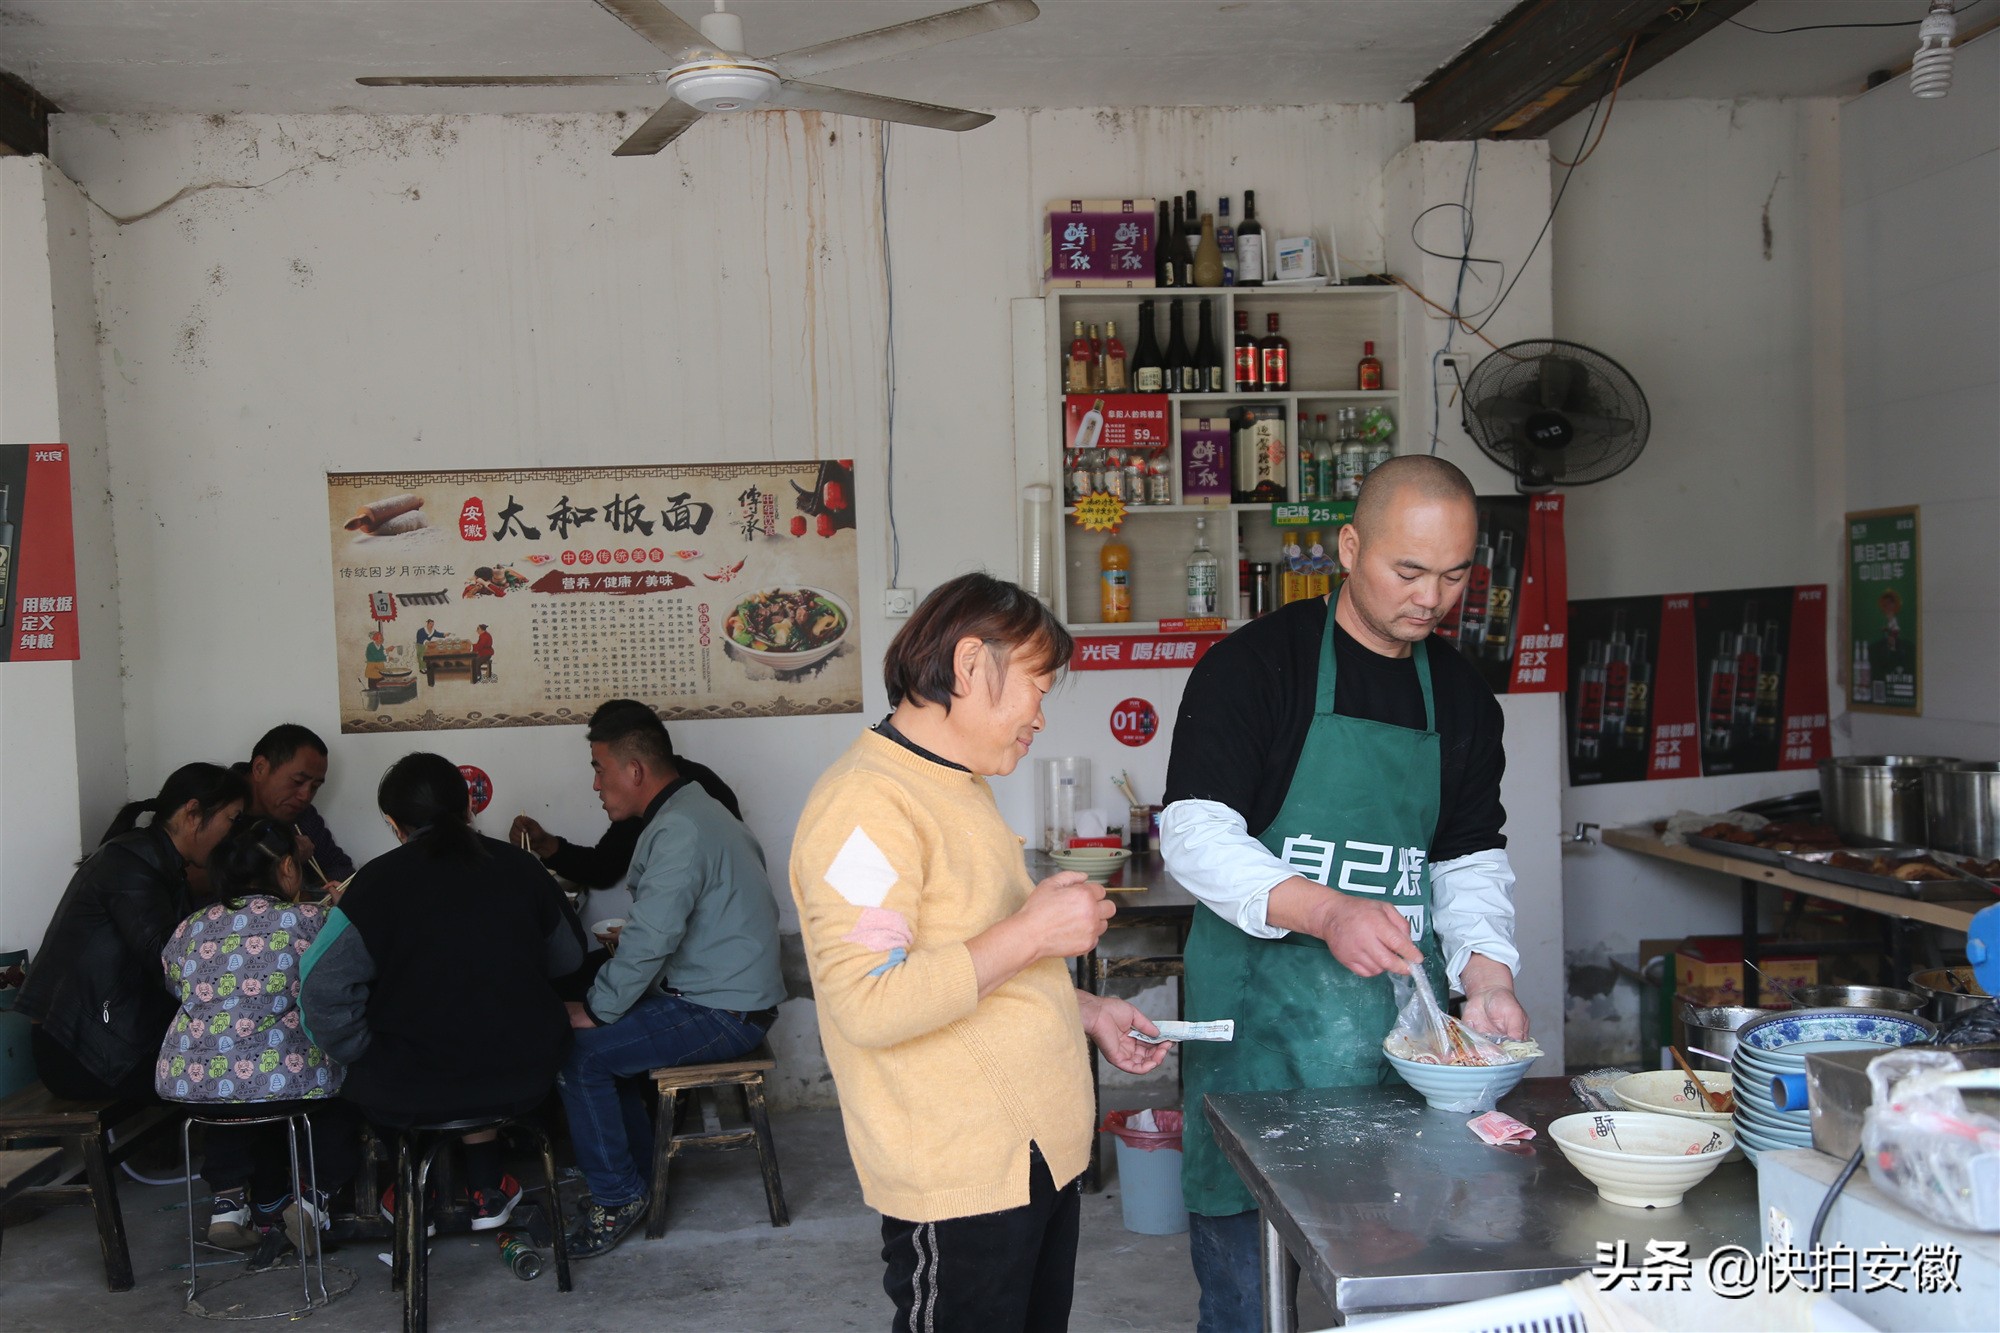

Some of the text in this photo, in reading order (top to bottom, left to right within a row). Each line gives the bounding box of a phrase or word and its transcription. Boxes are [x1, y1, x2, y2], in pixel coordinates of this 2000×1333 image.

[1134, 429, 1151, 440] 59
[35, 451, 63, 462] 光良
[463, 505, 483, 538] 安徽
[492, 492, 714, 542] 太和板面
[561, 548, 664, 566] 中华传统美食
[340, 564, 456, 579] 传统因岁月而荣光
[22, 596, 73, 613] 用数据
[21, 615, 55, 631] 定义
[20, 634, 54, 649] 纯粮
[1520, 633, 1566, 649] 用数据
[1082, 641, 1197, 661] 光良 喝纯粮
[1519, 651, 1548, 666] 定义
[1517, 668, 1547, 684] 纯粮
[1113, 710, 1137, 731] 01
[1787, 713, 1826, 729] 用数据
[1656, 722, 1695, 739] 用数据
[1786, 731, 1812, 744] 定义
[1655, 740, 1681, 754] 定义
